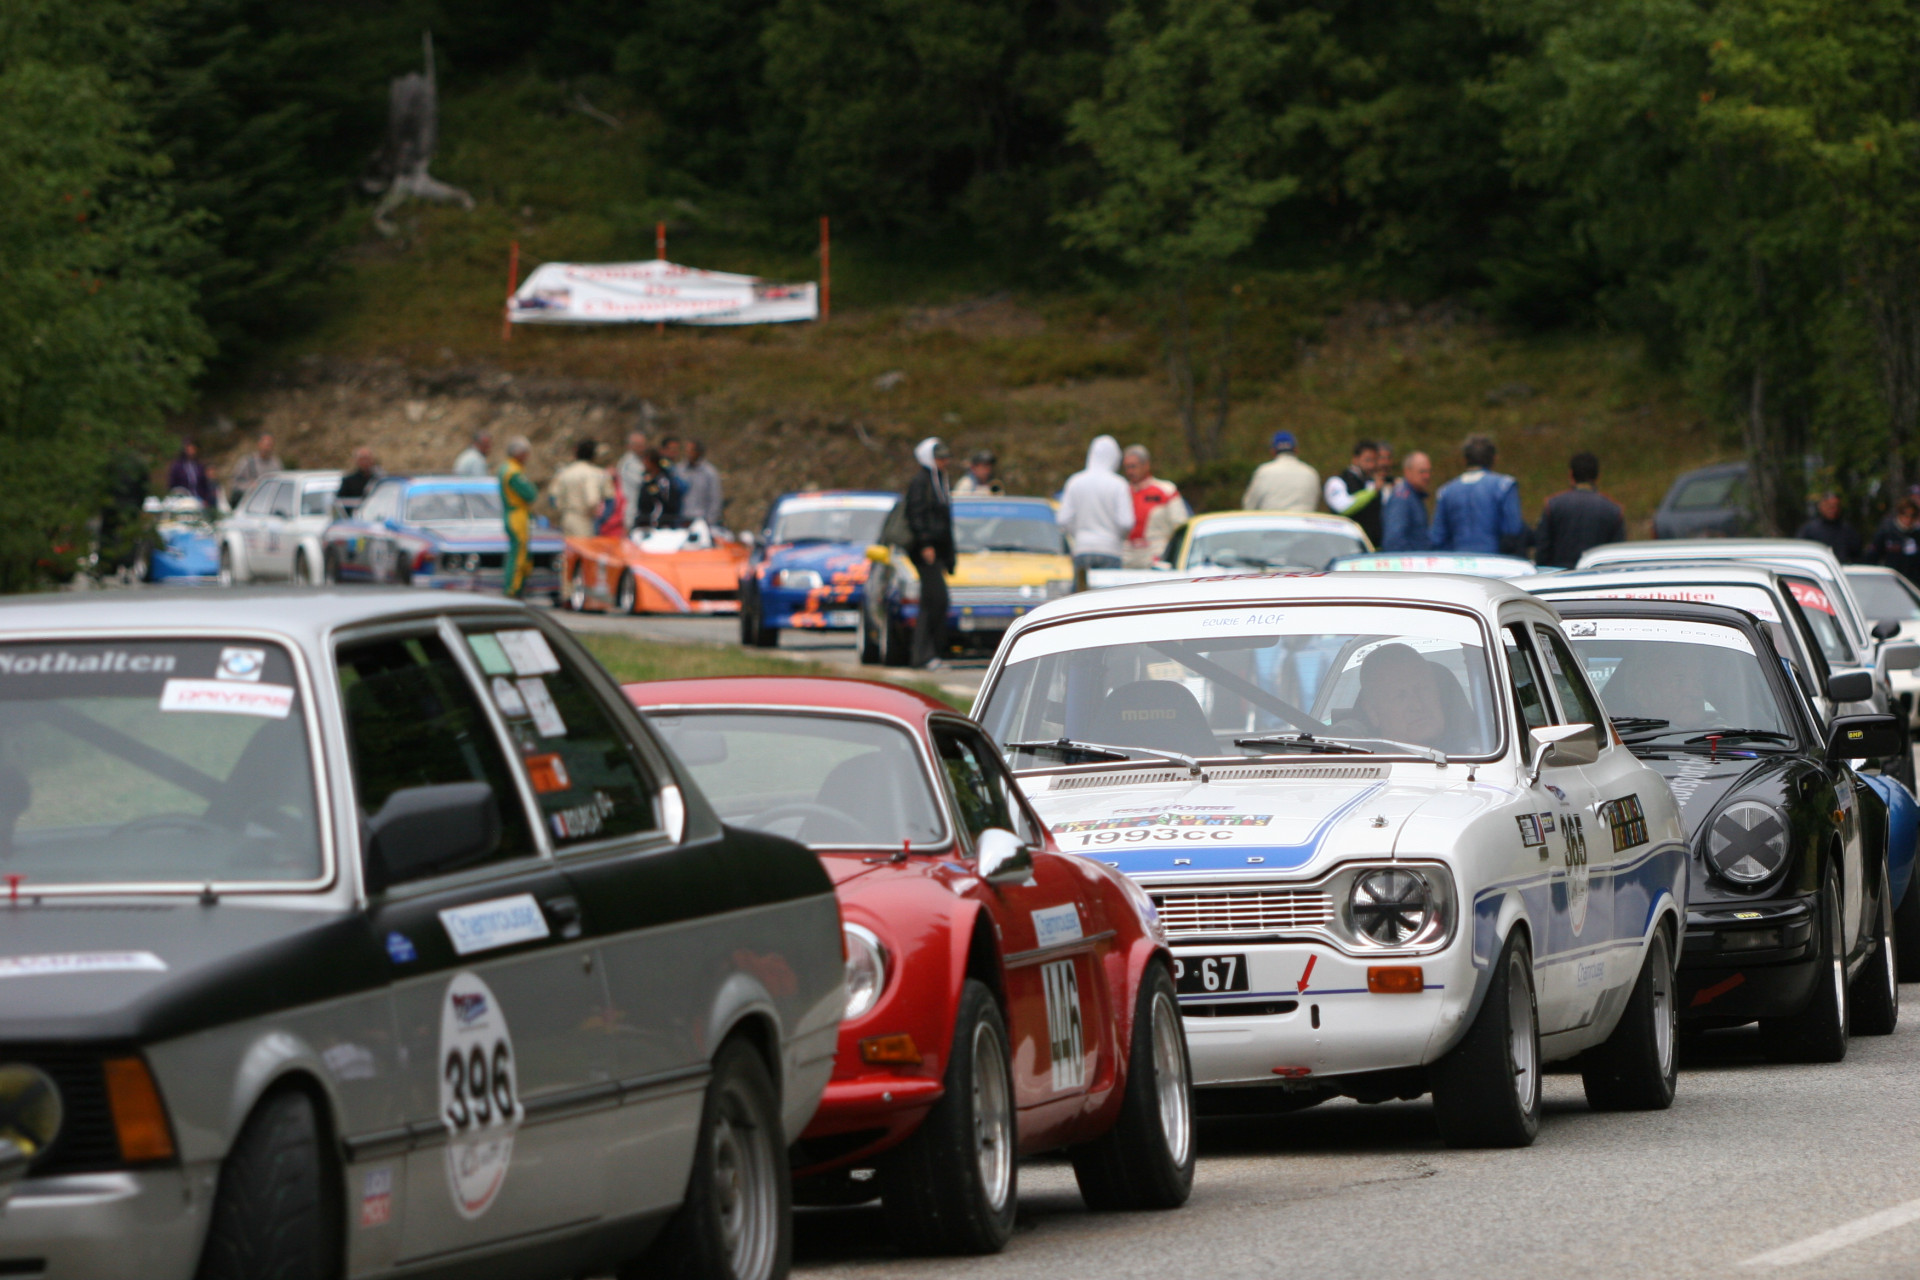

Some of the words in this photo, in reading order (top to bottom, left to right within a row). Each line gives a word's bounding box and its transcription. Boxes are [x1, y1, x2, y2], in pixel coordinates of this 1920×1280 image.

[1202, 617, 1240, 627] ECURIE
[1246, 614, 1285, 626] ALCF
[1077, 828, 1234, 846] 1993cc
[1559, 813, 1588, 876] 365
[1202, 956, 1237, 991] 67
[446, 1037, 514, 1129] 396
